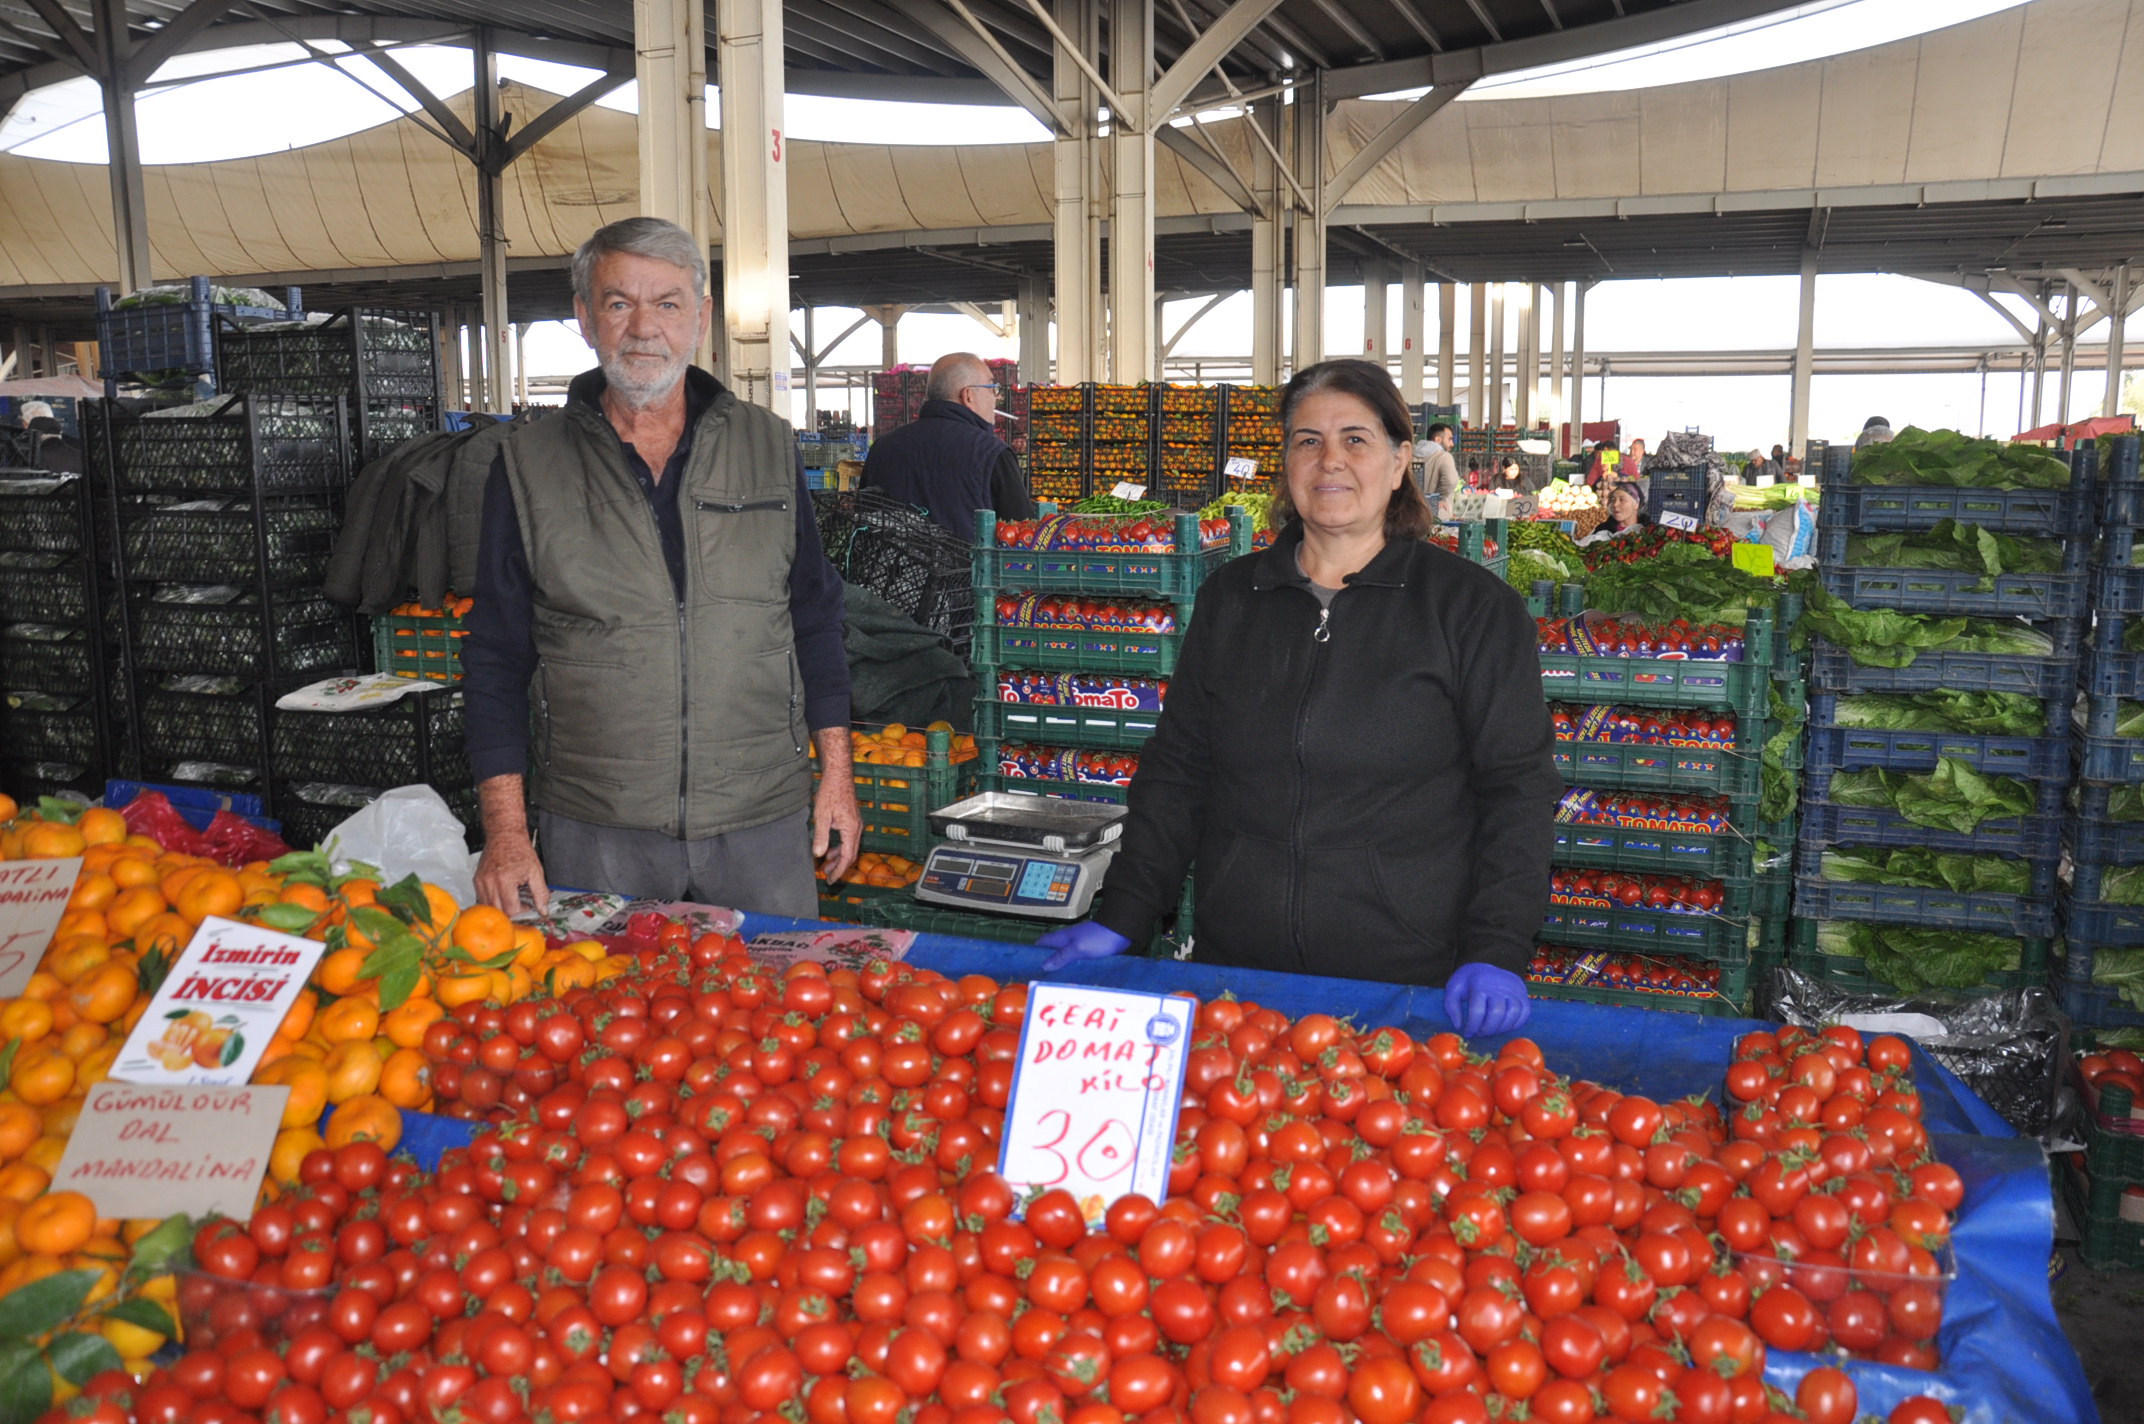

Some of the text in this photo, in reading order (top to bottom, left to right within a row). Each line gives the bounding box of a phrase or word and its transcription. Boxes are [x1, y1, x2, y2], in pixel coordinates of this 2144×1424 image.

[771, 128, 781, 163] 3
[501, 330, 507, 343] 5
[1366, 338, 1373, 351] 6
[1404, 337, 1411, 350] 6
[1511, 500, 1533, 518] 30
[1665, 514, 1694, 528] 20
[1072, 688, 1138, 709] omaTo
[1617, 816, 1712, 833] TOMATO
[0, 866, 59, 884] ATLI
[0, 887, 70, 904] DALİNA
[199, 938, 301, 966] İzmirin
[170, 970, 291, 1002] İNCİSİ
[1080, 1070, 1167, 1094] KİLO
[118, 1118, 181, 1144] DAL
[1004, 1109, 1138, 1186] 30
[70, 1154, 257, 1183] MANDALİNA
